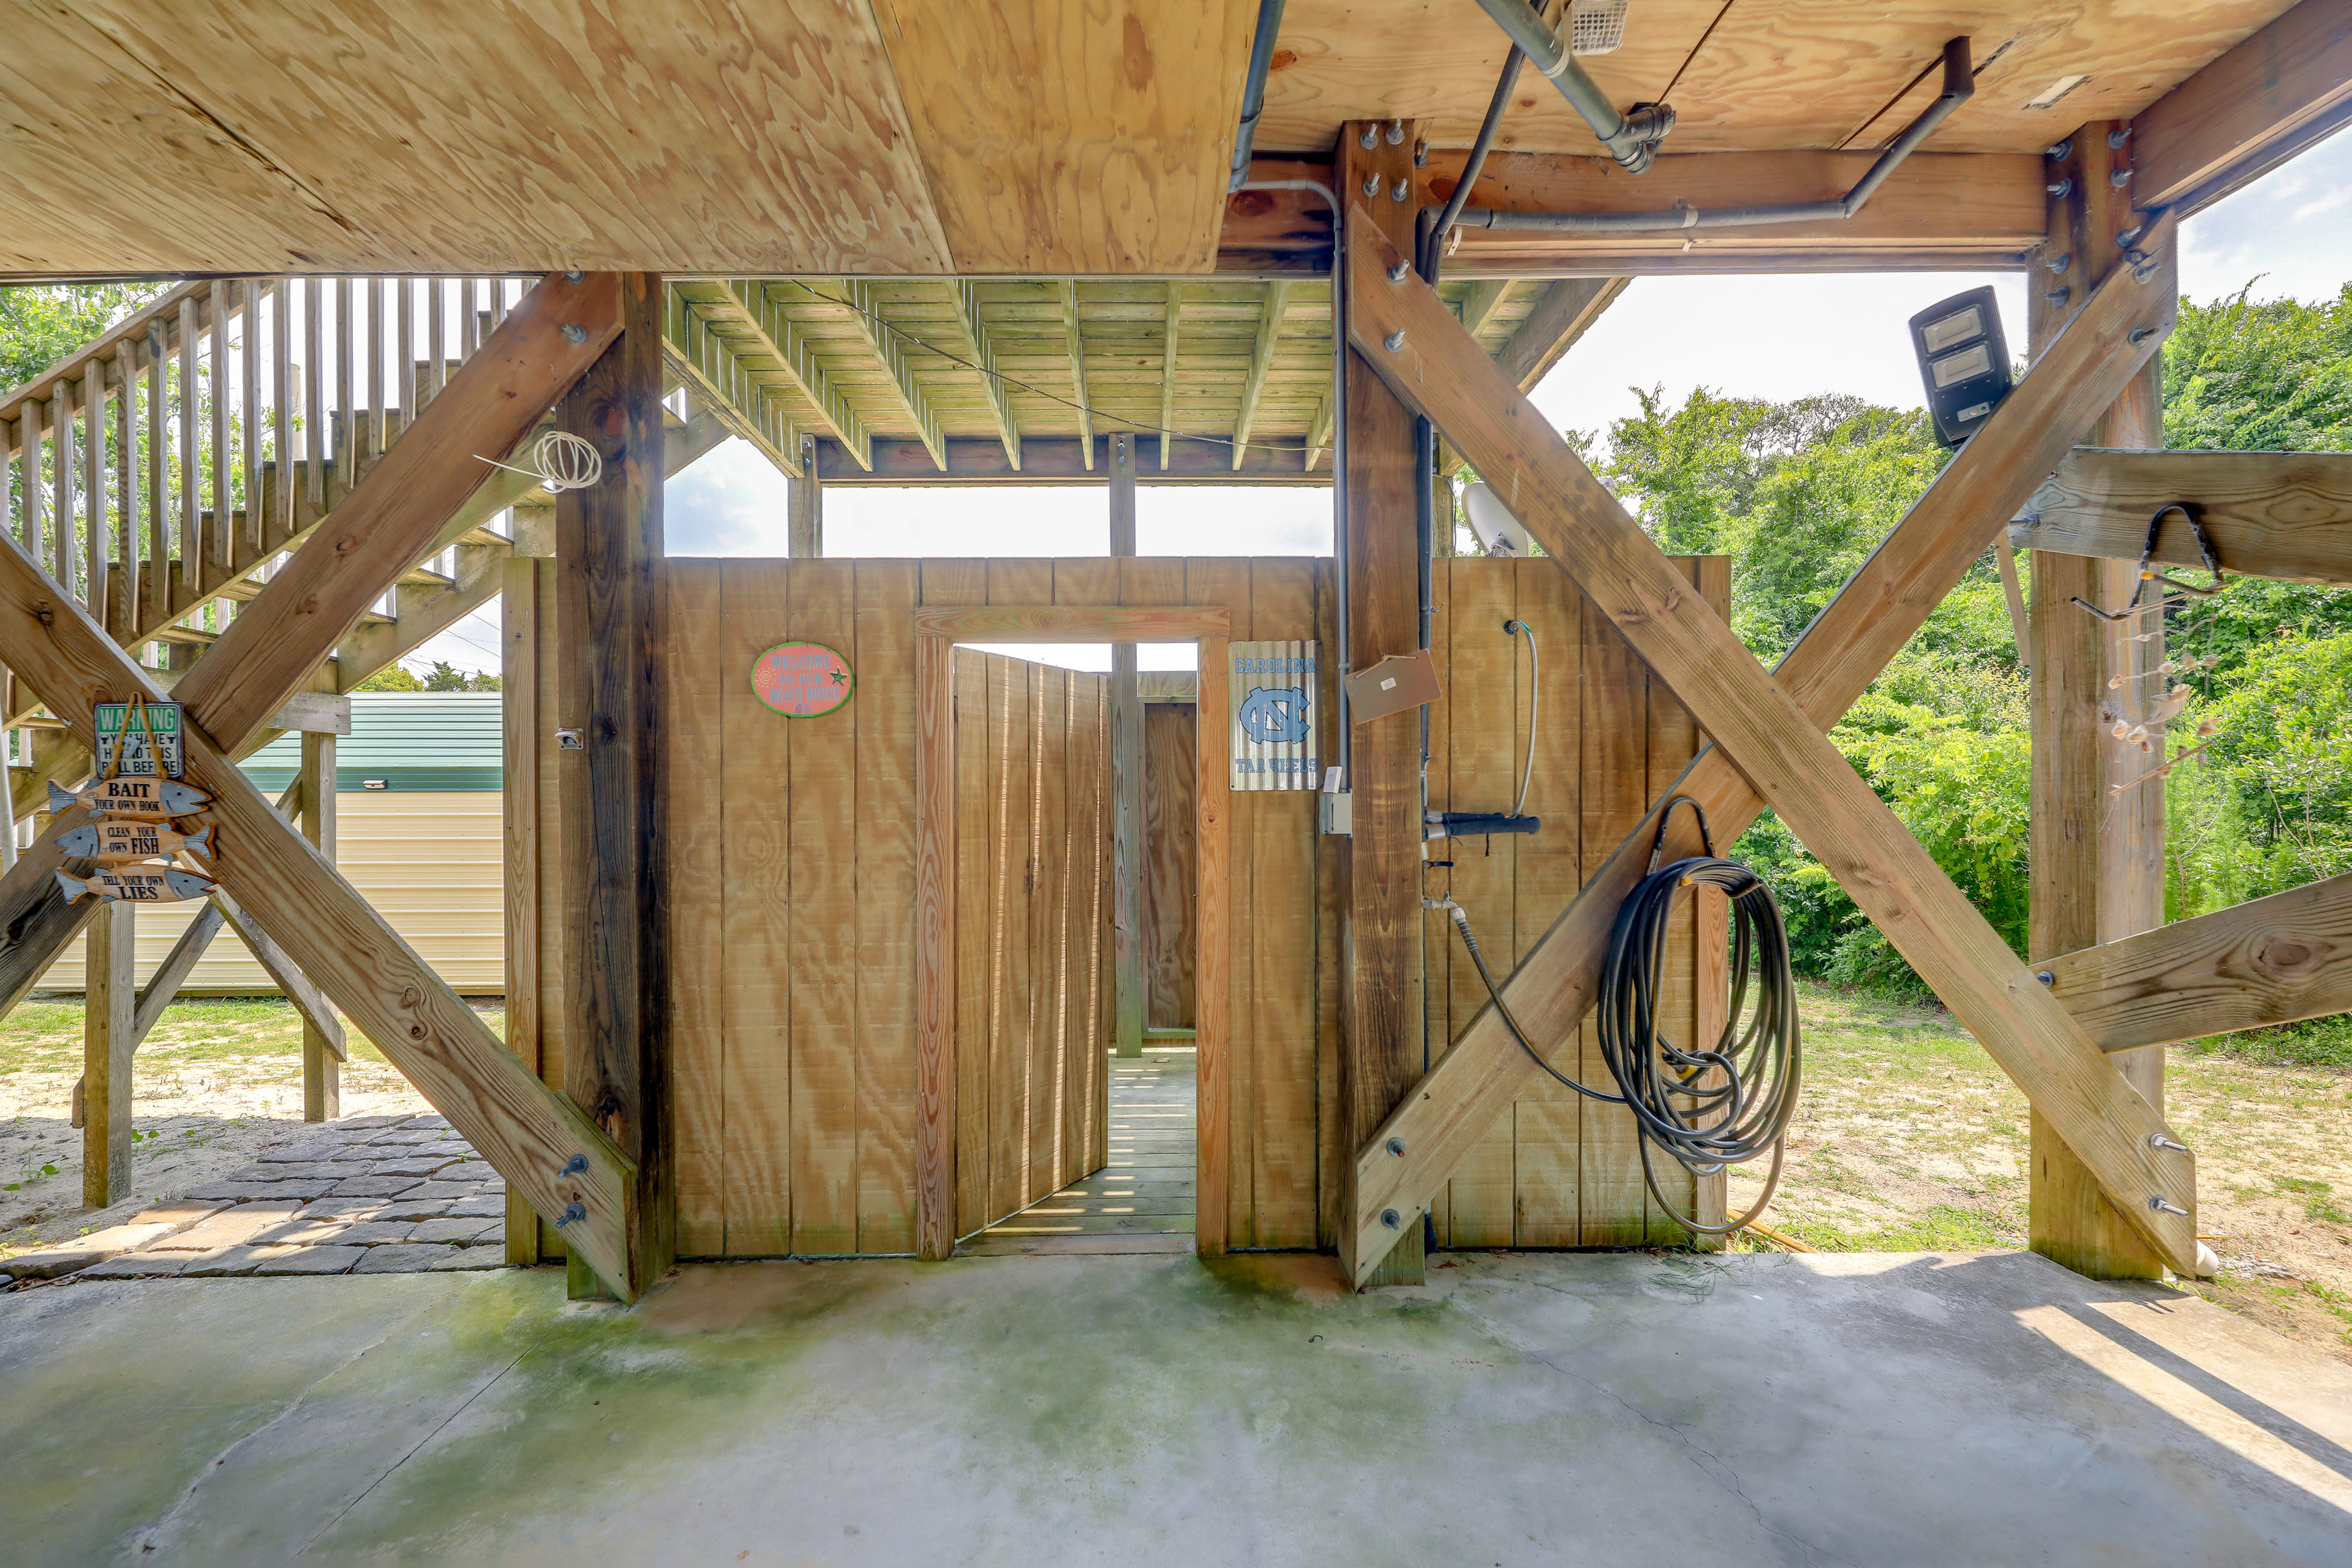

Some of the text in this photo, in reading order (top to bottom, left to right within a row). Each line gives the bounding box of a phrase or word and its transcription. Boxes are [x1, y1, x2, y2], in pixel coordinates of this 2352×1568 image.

[771, 654, 831, 671] WELCOME
[1235, 658, 1317, 673] CAROLINA
[778, 674, 823, 686] TO OUR
[769, 687, 840, 703] BEACH HOUSE
[100, 708, 175, 729] WARNING
[133, 761, 176, 772] BEFRE
[1235, 758, 1318, 773] TAR HEELS
[108, 783, 150, 797] BAIT
[94, 799, 160, 811] YOUR OWN HOOK
[108, 827, 157, 837] CLEAN YOUR
[110, 837, 160, 854] OWN FISH
[102, 875, 164, 886] TELL YOUR OWN
[118, 886, 159, 899] LIES
